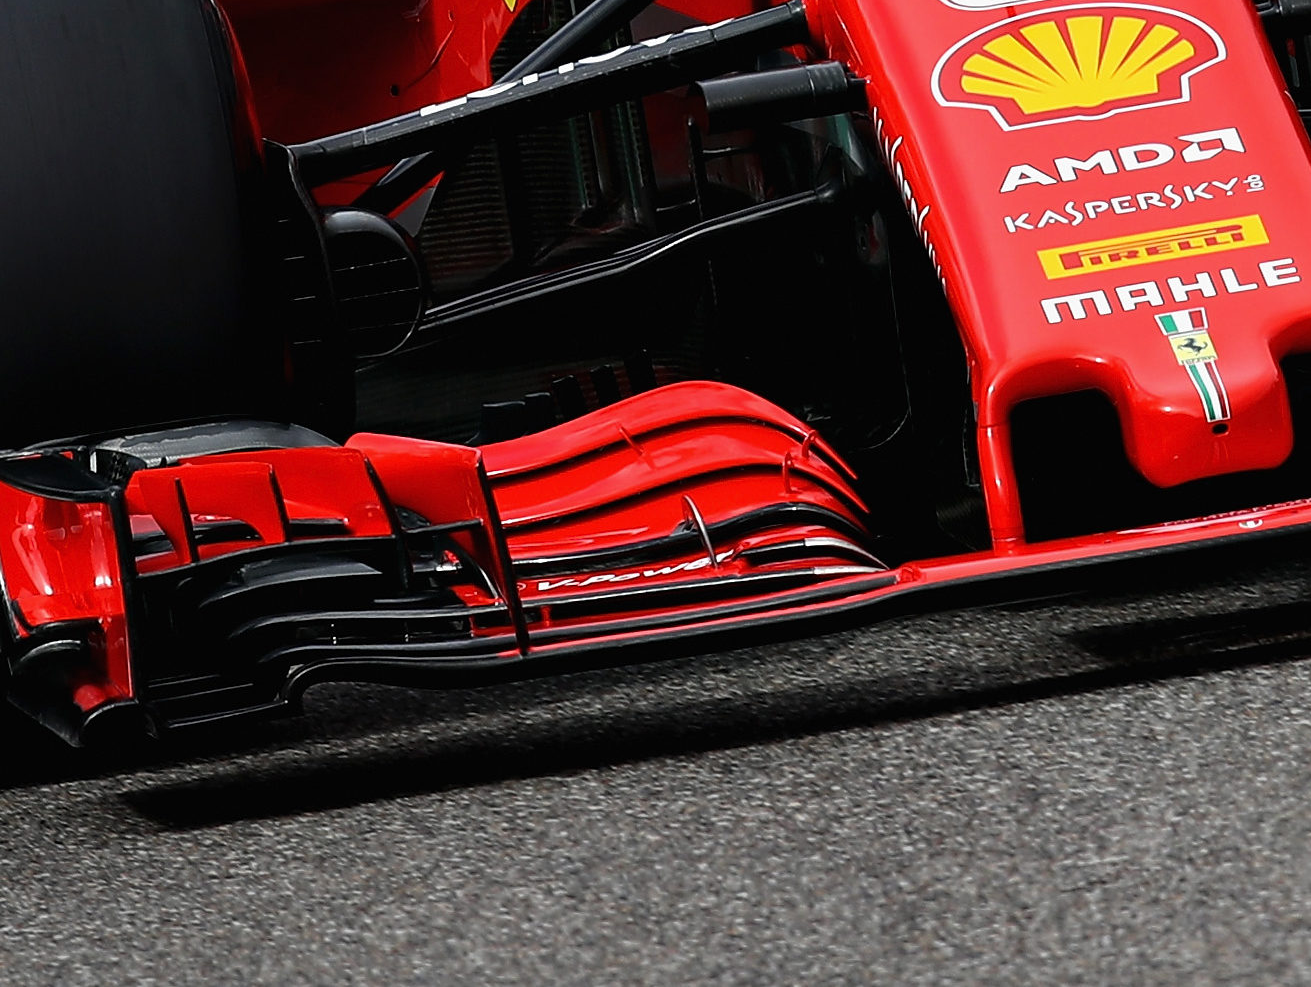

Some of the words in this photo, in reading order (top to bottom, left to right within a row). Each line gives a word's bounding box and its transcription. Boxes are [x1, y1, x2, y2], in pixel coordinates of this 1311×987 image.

[1004, 177, 1239, 233] KASPERSKY
[1059, 225, 1244, 270] PIRELLI
[1040, 258, 1302, 324] MAHLE
